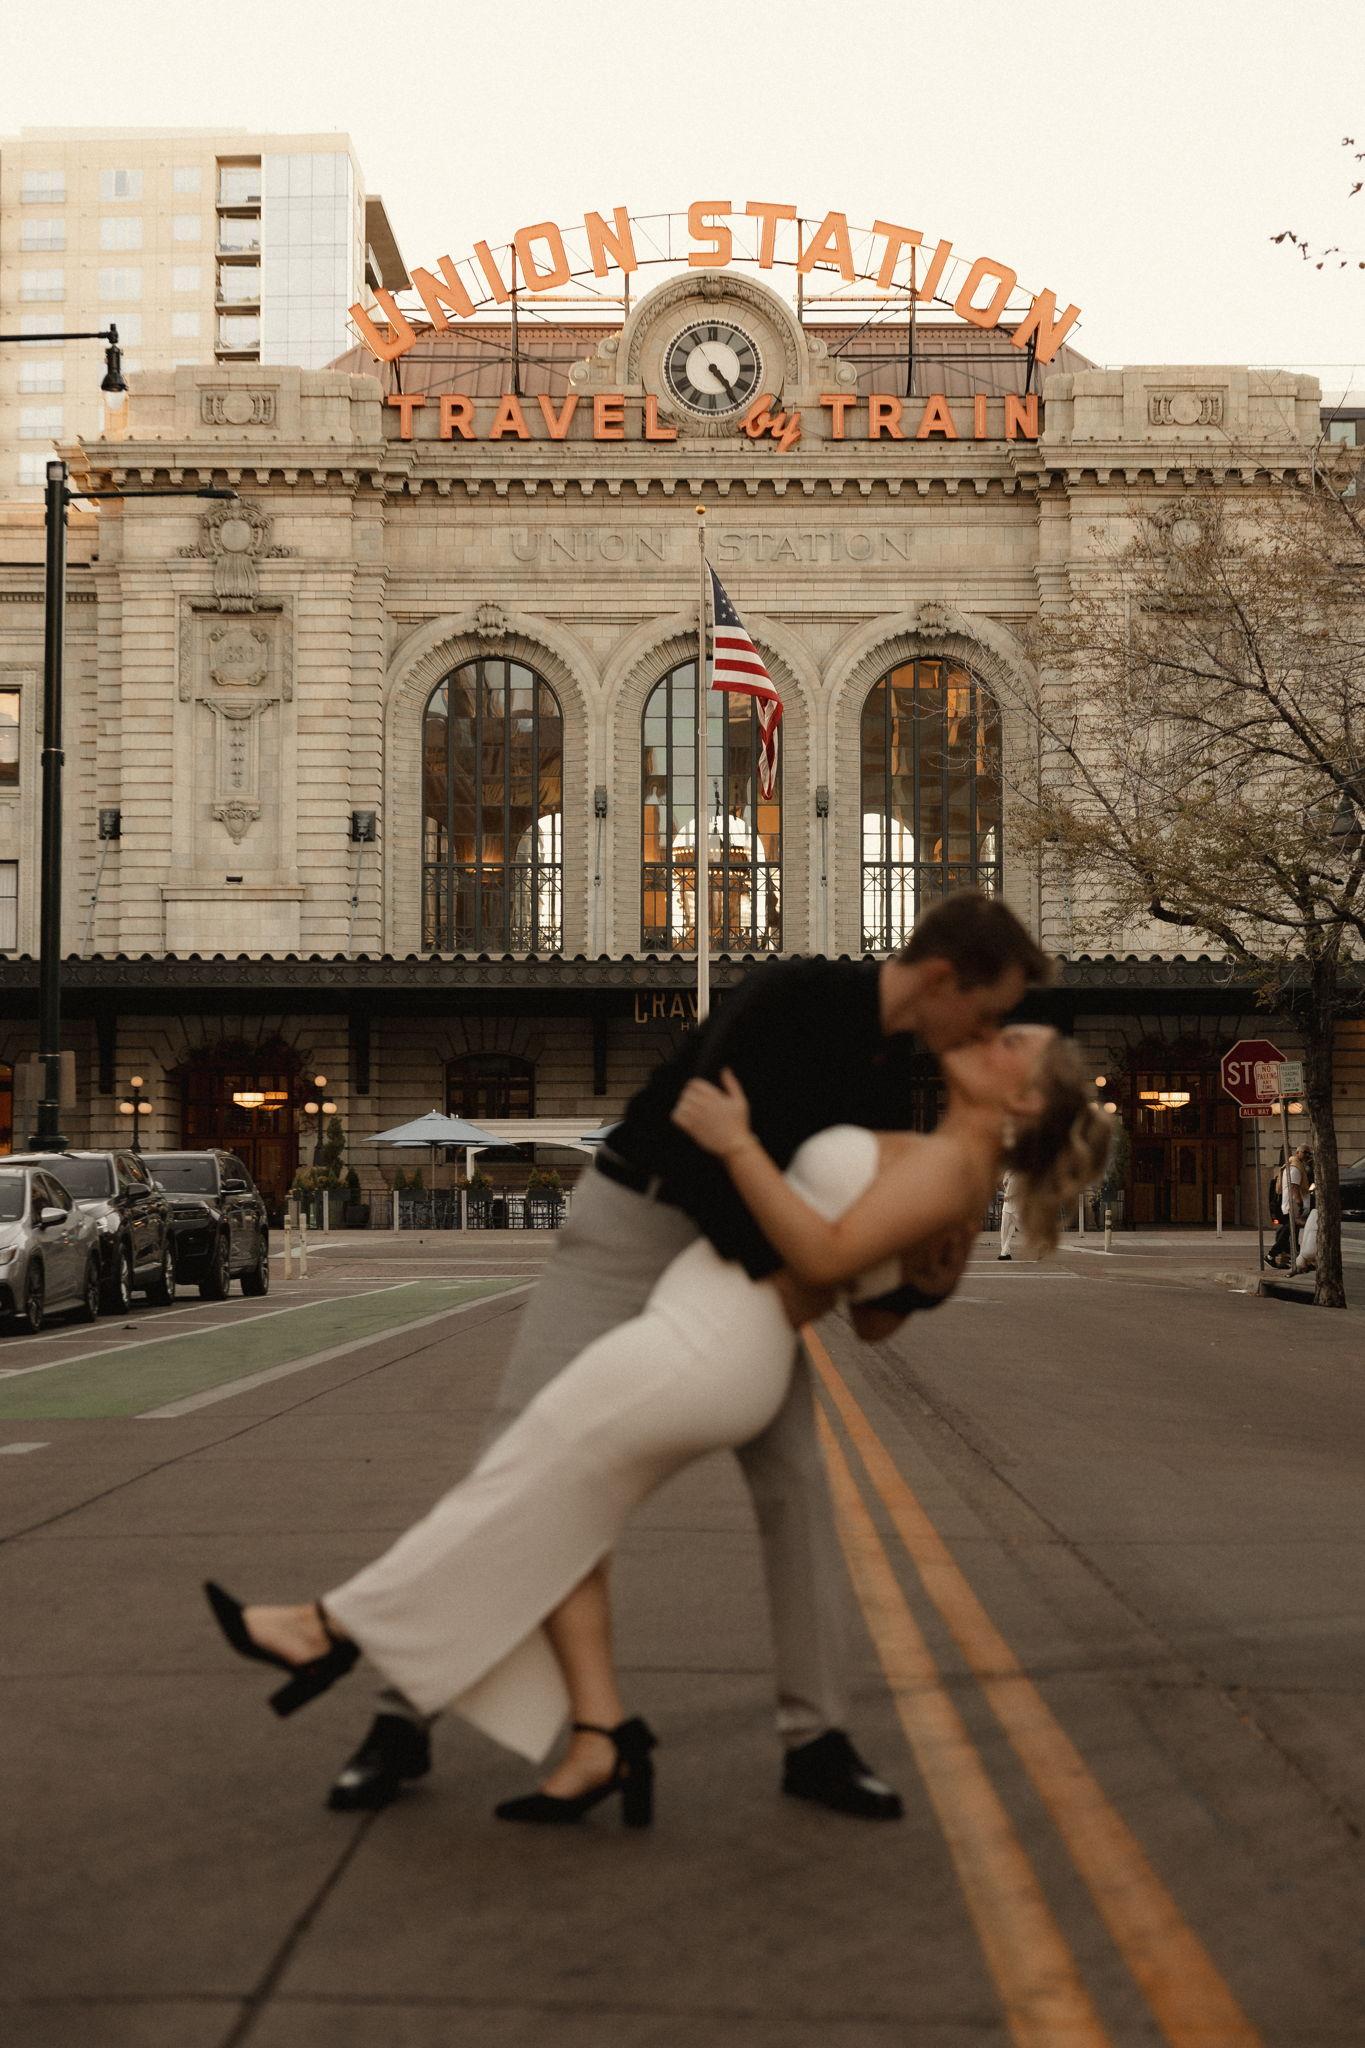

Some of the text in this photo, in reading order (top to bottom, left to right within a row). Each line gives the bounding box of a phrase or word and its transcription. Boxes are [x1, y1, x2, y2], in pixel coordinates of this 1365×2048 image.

[348, 201, 1081, 365] UNION STATION
[388, 393, 1039, 453] TRAVEL by TRAIN
[510, 532, 913, 562] UNION STATION
[1227, 1061, 1281, 1085] ST
